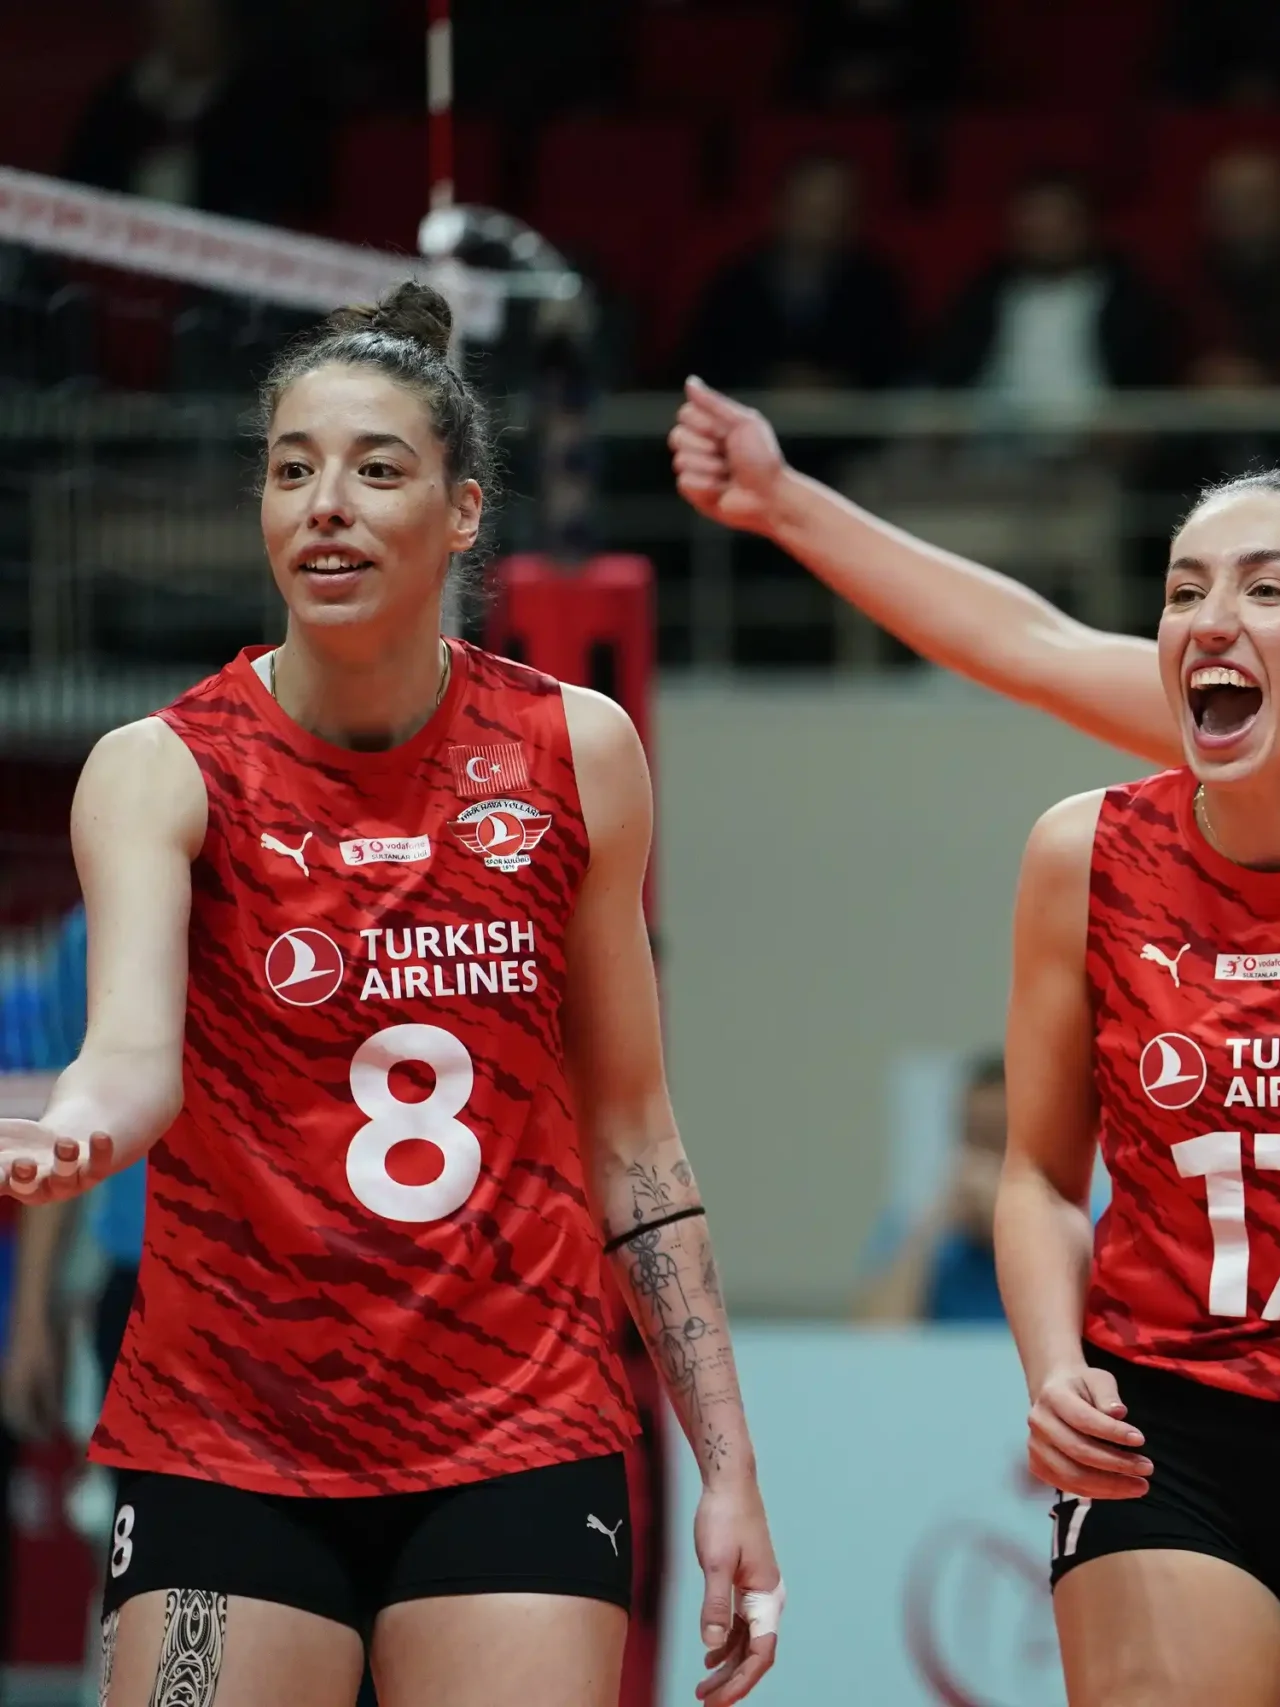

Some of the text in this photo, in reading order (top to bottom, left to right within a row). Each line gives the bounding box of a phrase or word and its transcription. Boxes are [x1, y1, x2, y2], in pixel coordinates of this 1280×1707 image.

[385, 841, 426, 850] vodafone
[359, 920, 535, 961] TURKISH
[359, 959, 538, 1001] AIRLINES
[346, 1023, 482, 1223] 8
[111, 1504, 135, 1578] 8
